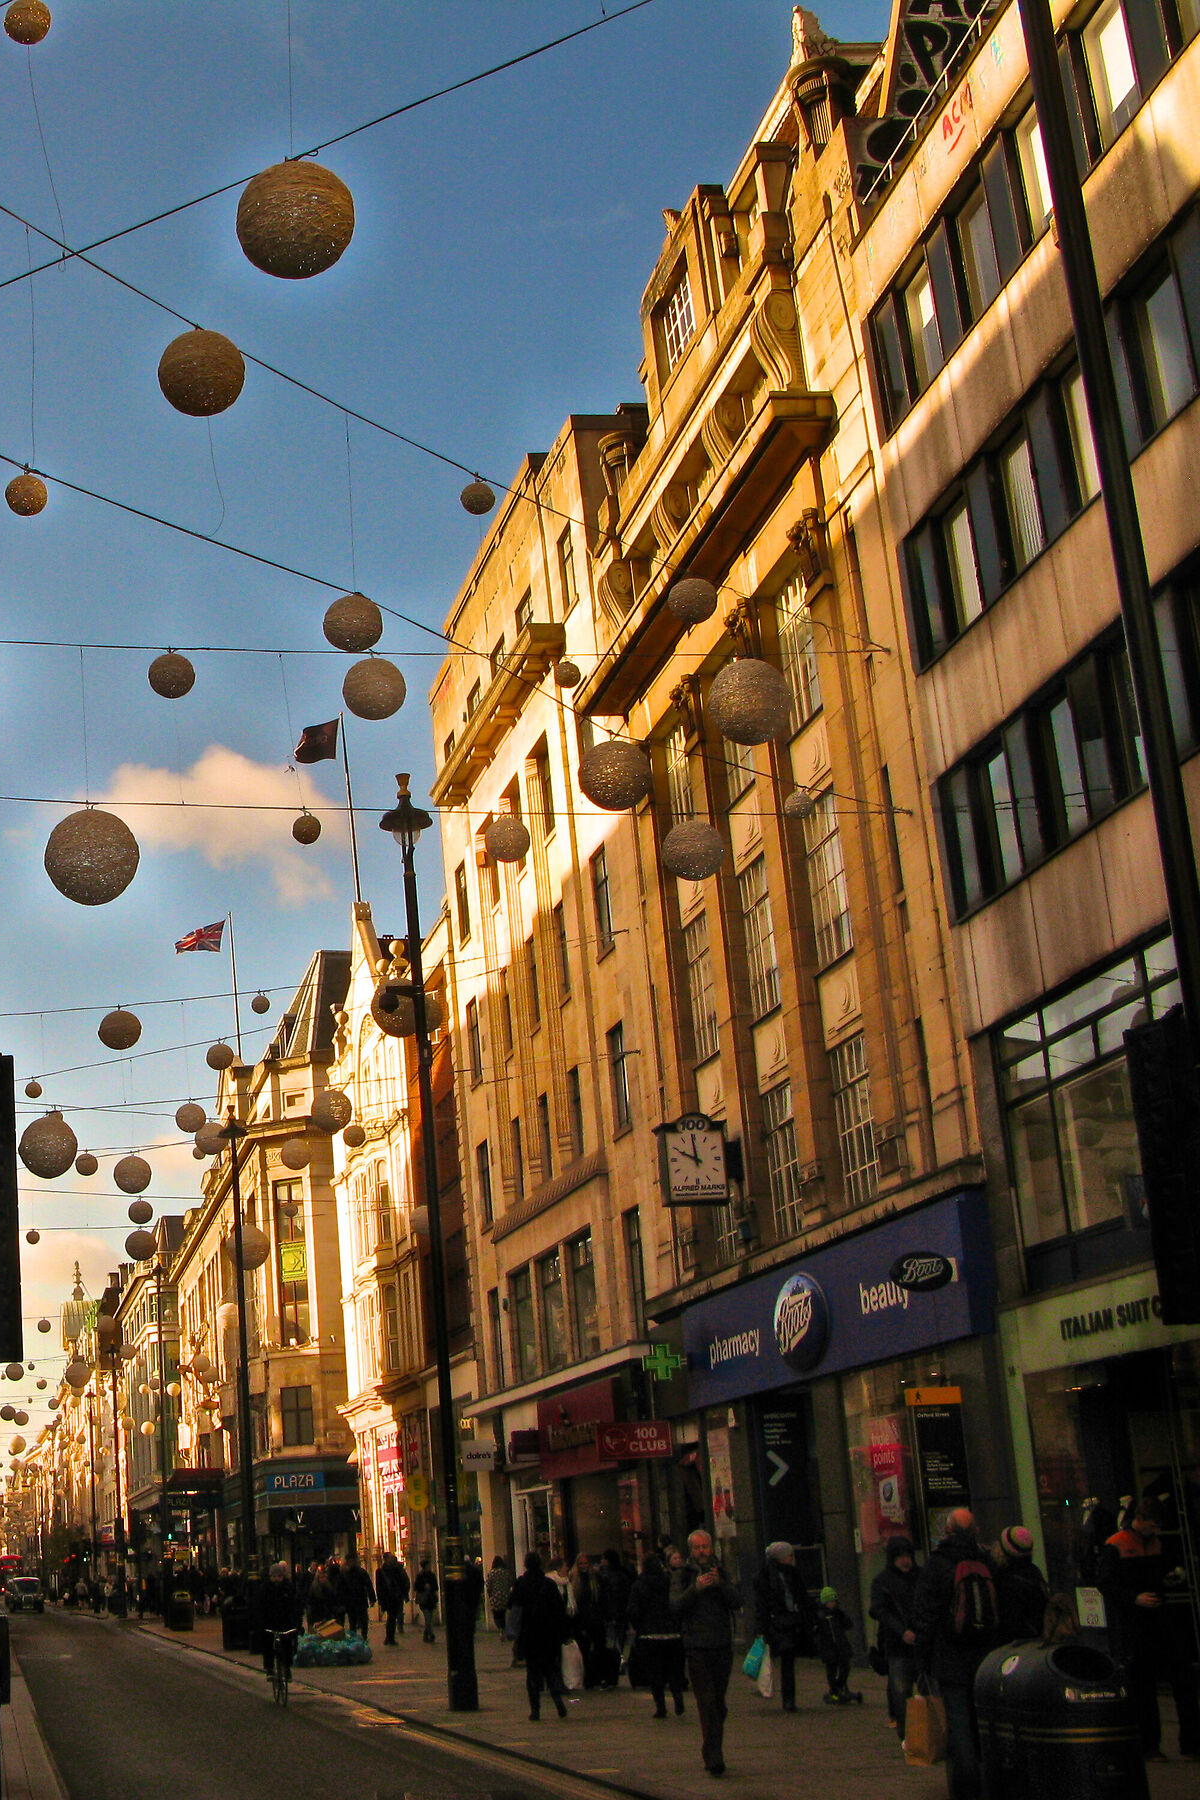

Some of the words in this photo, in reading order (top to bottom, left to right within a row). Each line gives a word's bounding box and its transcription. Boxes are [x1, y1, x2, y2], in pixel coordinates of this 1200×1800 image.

[679, 1119, 706, 1131] 100
[899, 1258, 944, 1283] Boots
[858, 1281, 909, 1315] beauty
[776, 1290, 813, 1355] Boots
[1060, 1307, 1114, 1340] ITALIAN
[1117, 1297, 1149, 1327] SUIT
[710, 1328, 760, 1369] pharmacy
[629, 1439, 668, 1451] CLUB
[634, 1427, 657, 1439] 100
[274, 1474, 315, 1489] PLAZA
